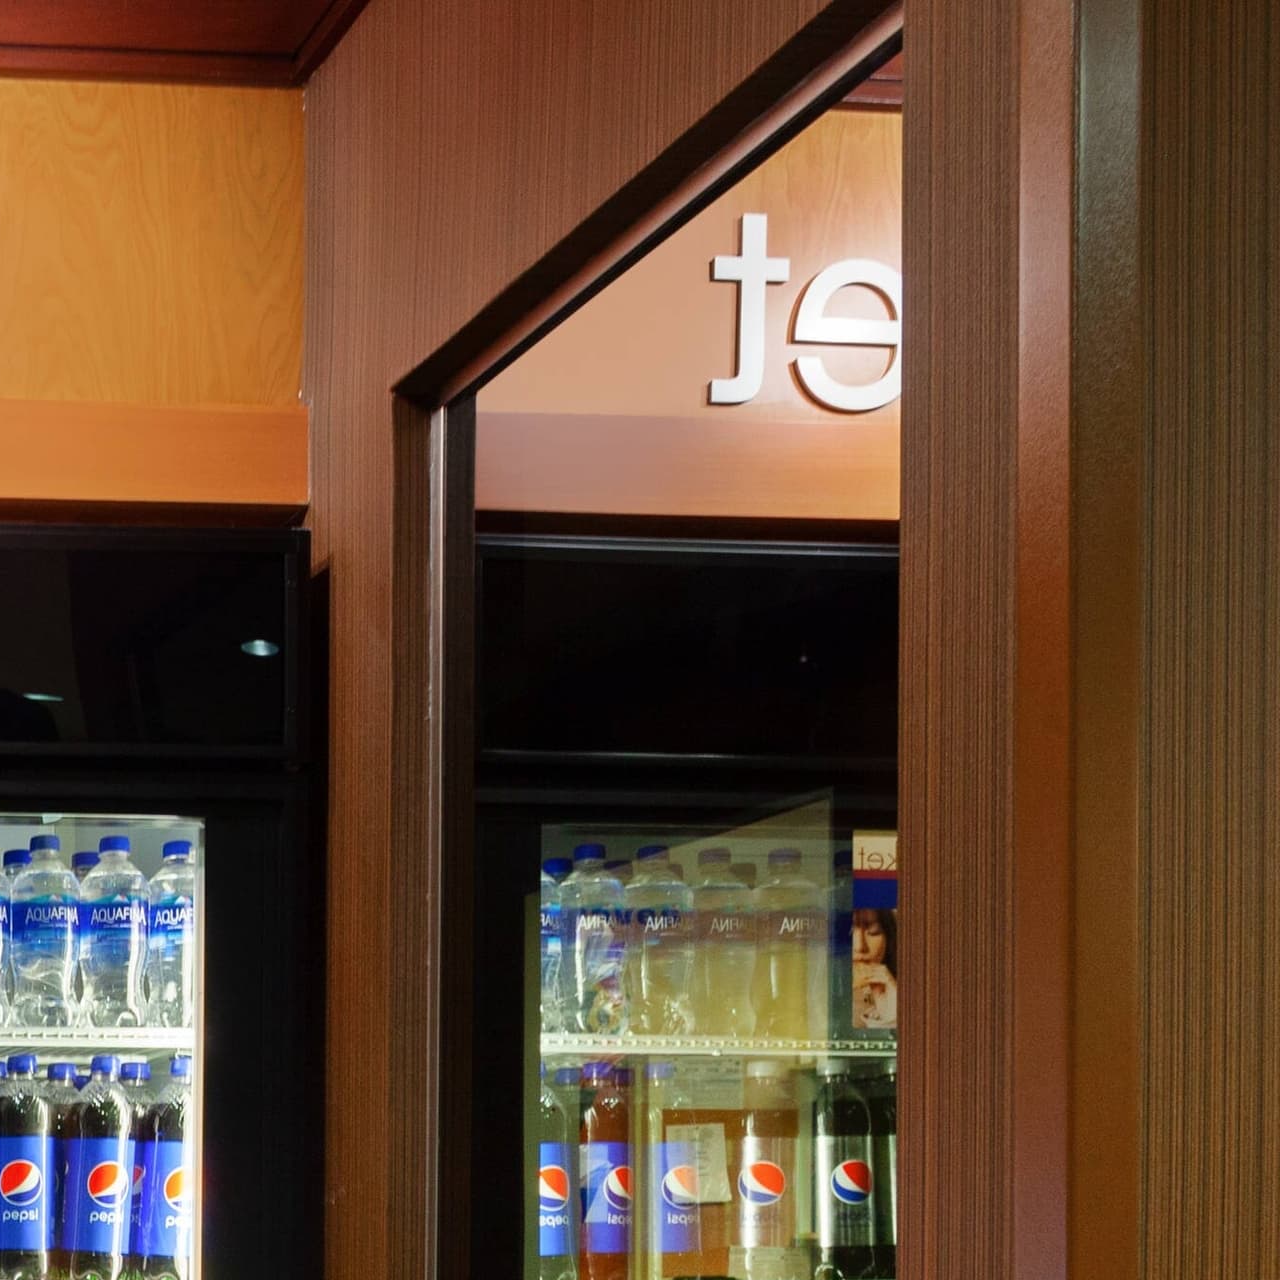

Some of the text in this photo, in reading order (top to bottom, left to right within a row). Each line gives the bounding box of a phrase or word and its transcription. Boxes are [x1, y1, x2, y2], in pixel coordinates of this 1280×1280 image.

[25, 904, 79, 926] AQUAFINA
[91, 904, 148, 926] AQUAFINA
[2, 1208, 39, 1222] pepsi
